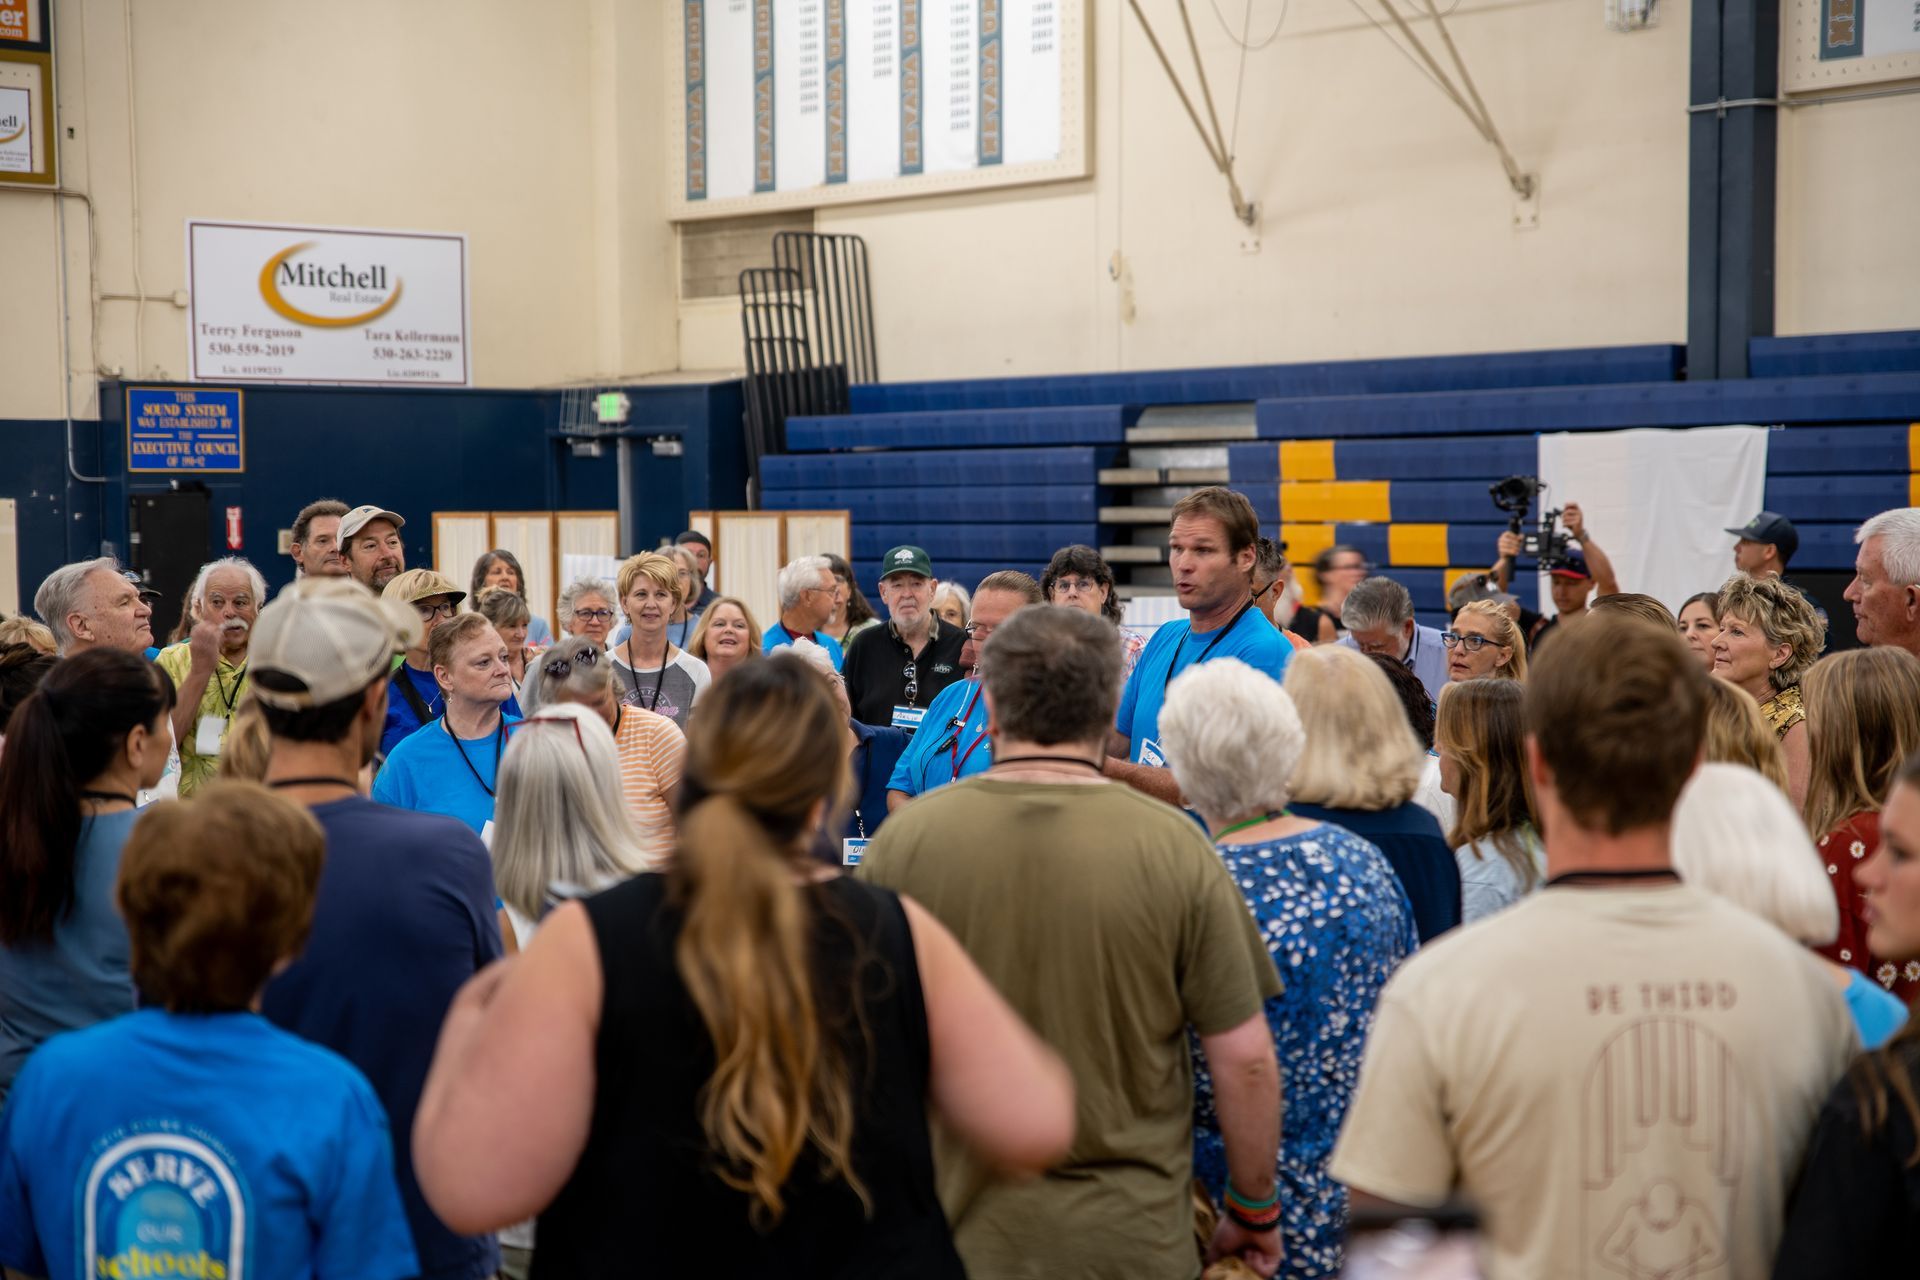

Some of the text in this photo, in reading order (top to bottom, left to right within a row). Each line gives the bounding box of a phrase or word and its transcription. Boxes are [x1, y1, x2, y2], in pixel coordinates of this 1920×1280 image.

[982, 38, 999, 157] NEVADA
[902, 51, 919, 165] NEVADA
[757, 75, 772, 183] NEVADA
[828, 64, 845, 176] NEVADA
[687, 88, 705, 192] NEVADA
[280, 260, 387, 290] Mitchell
[329, 291, 384, 304] Real Estate
[200, 323, 303, 340] Terry Ferguson
[364, 328, 460, 344] Tara Kellermann
[207, 342, 296, 357] 530-559-2019
[175, 392, 196, 403] THIS
[143, 403, 227, 417] SOUND SYSTEM
[137, 417, 232, 429] WAS ESTABLISHED BY
[133, 442, 239, 455] EXECUTIVE COUNCIL
[166, 456, 178, 467] OF
[1639, 980, 1738, 1012] THIRD
[107, 1152, 219, 1208] SERVE
[136, 1220, 184, 1244] OUR
